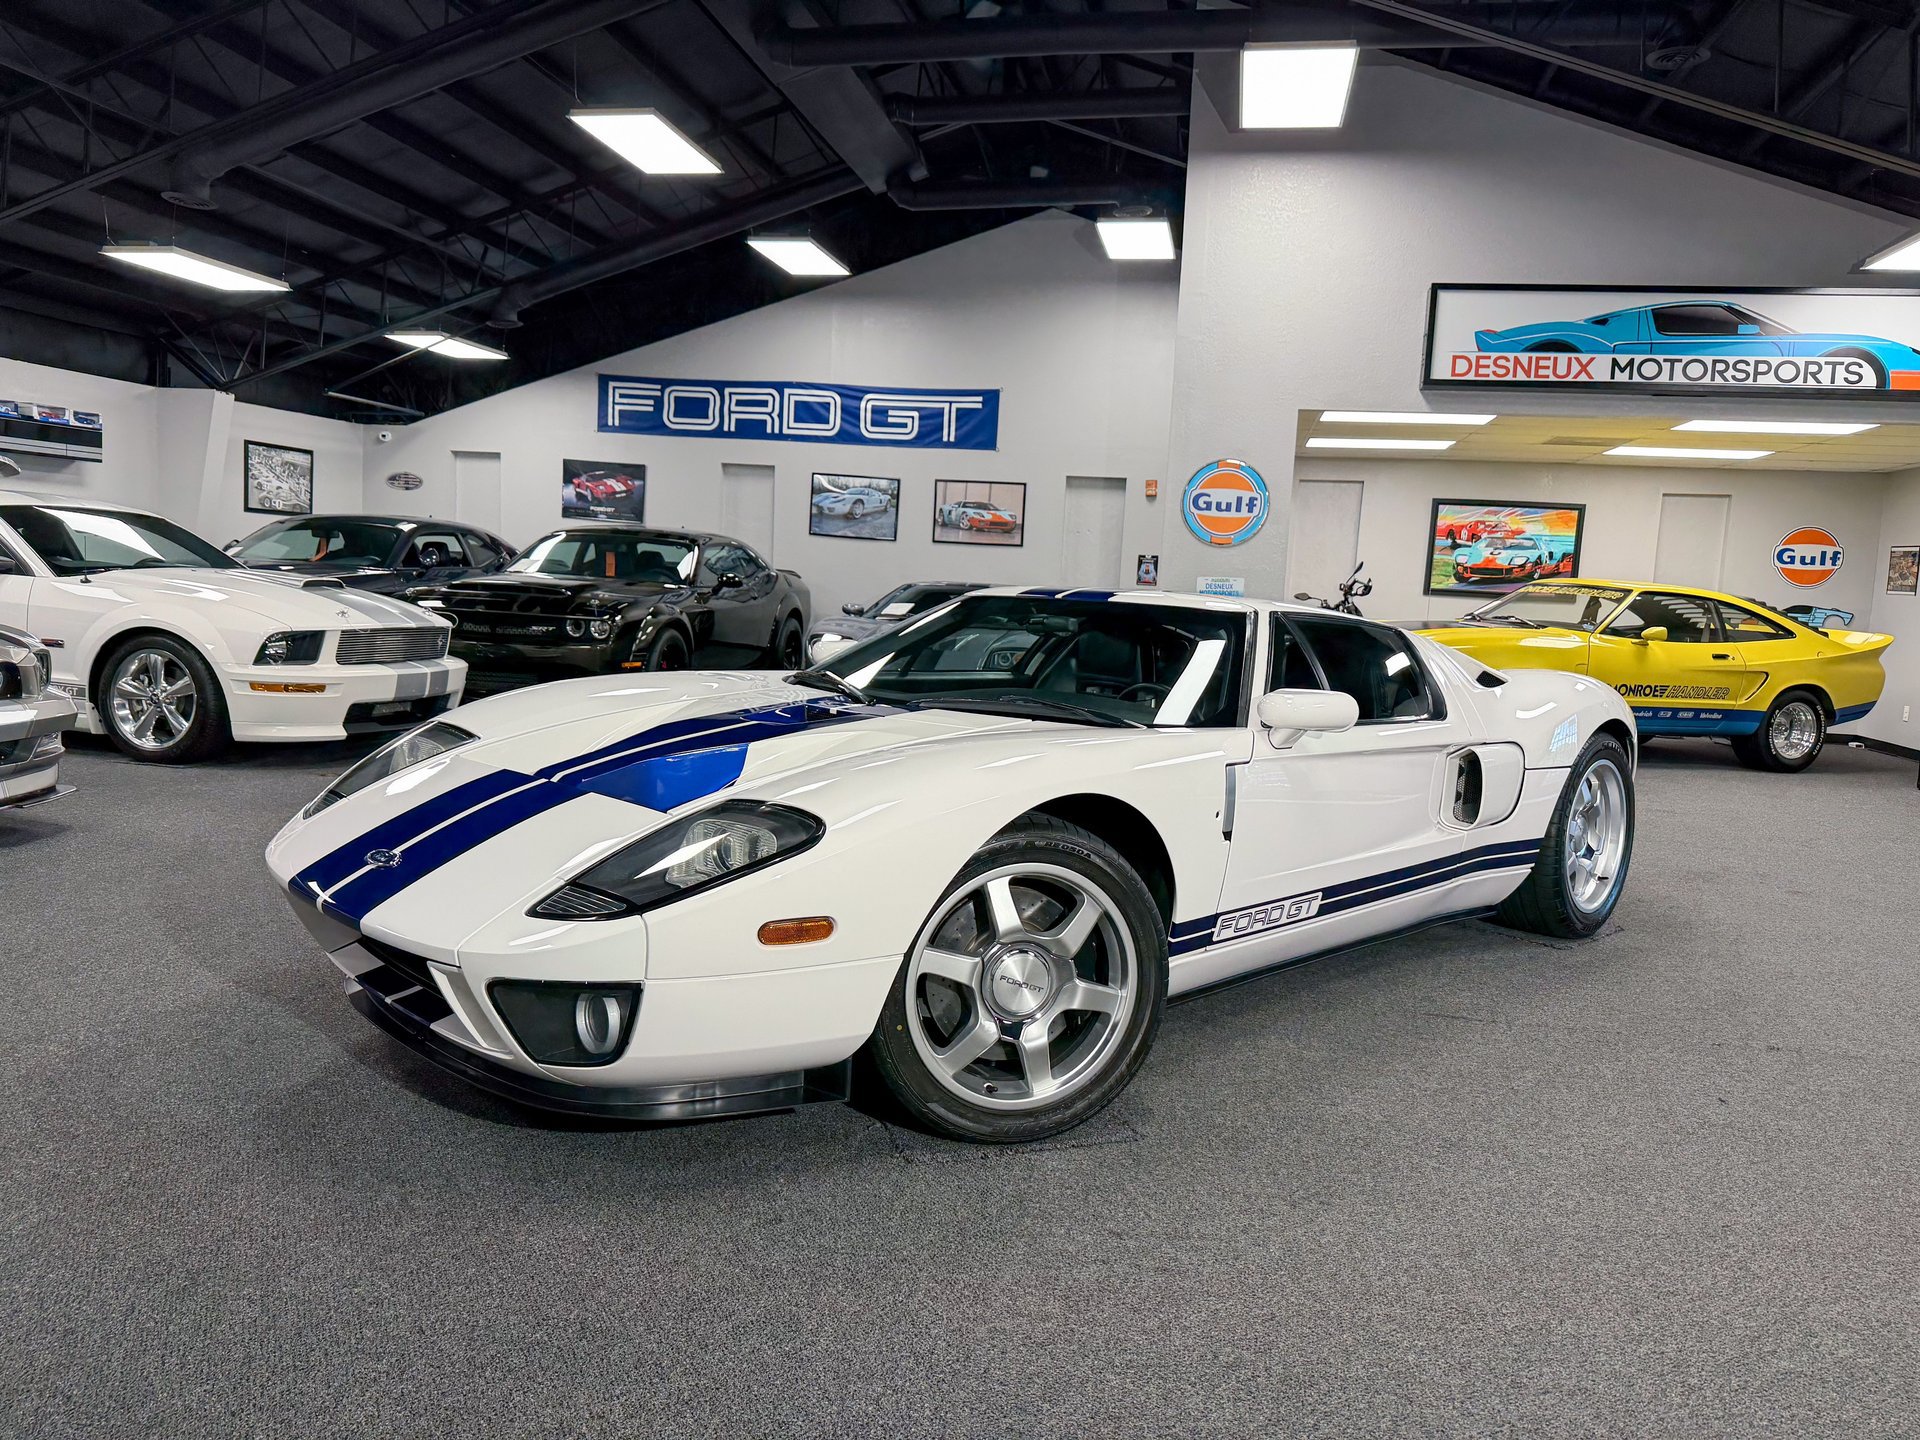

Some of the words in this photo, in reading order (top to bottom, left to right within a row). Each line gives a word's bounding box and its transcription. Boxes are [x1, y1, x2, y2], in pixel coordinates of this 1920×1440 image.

[1450, 354, 1595, 380] DESNEUX
[1610, 357, 1864, 386] MOTORSPORTS
[607, 381, 842, 437] FORD
[860, 393, 983, 442] GT
[1192, 492, 1258, 514] Gulf
[1776, 548, 1842, 567] Gulf
[65, 687, 78, 696] GT
[1666, 685, 1730, 699] HANDLER
[1217, 903, 1285, 938] FORD
[1286, 895, 1319, 920] GT
[999, 975, 1029, 989] FORD
[1028, 984, 1045, 993] GT
